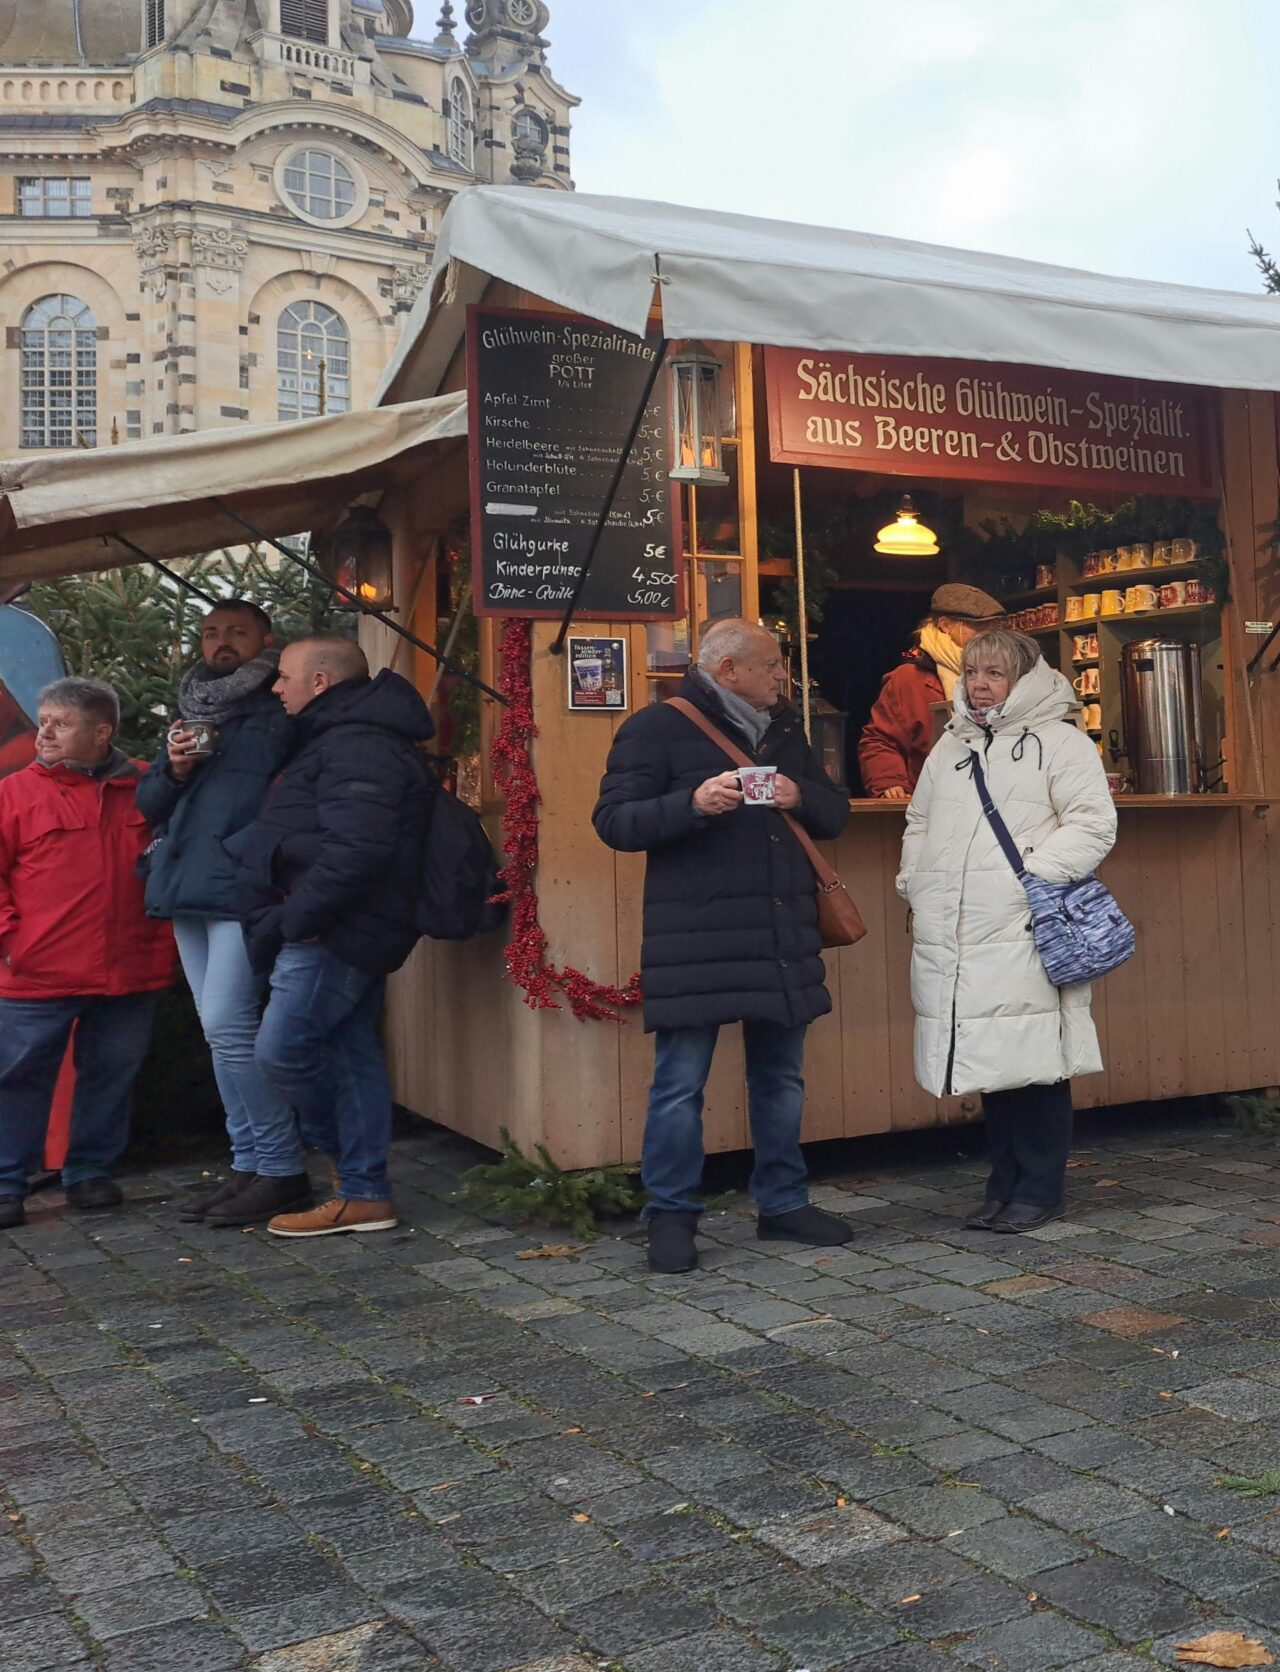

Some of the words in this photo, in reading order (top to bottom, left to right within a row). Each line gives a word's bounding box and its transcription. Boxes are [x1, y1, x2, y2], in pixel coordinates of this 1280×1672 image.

[551, 353, 594, 364] großer
[549, 364, 596, 380] POTT
[797, 359, 947, 414] Sächsische
[956, 376, 1190, 440] Glühwein-Spezialit.
[485, 415, 530, 429] Kirsche
[486, 436, 560, 451] Heidelbeere
[805, 416, 863, 446] aus
[1027, 430, 1186, 477] Obstweinen
[486, 459, 577, 476] Holunderblüte
[486, 481, 560, 497] Granatapfel
[643, 543, 667, 559] 5€
[496, 560, 591, 580] Kinderpunsc
